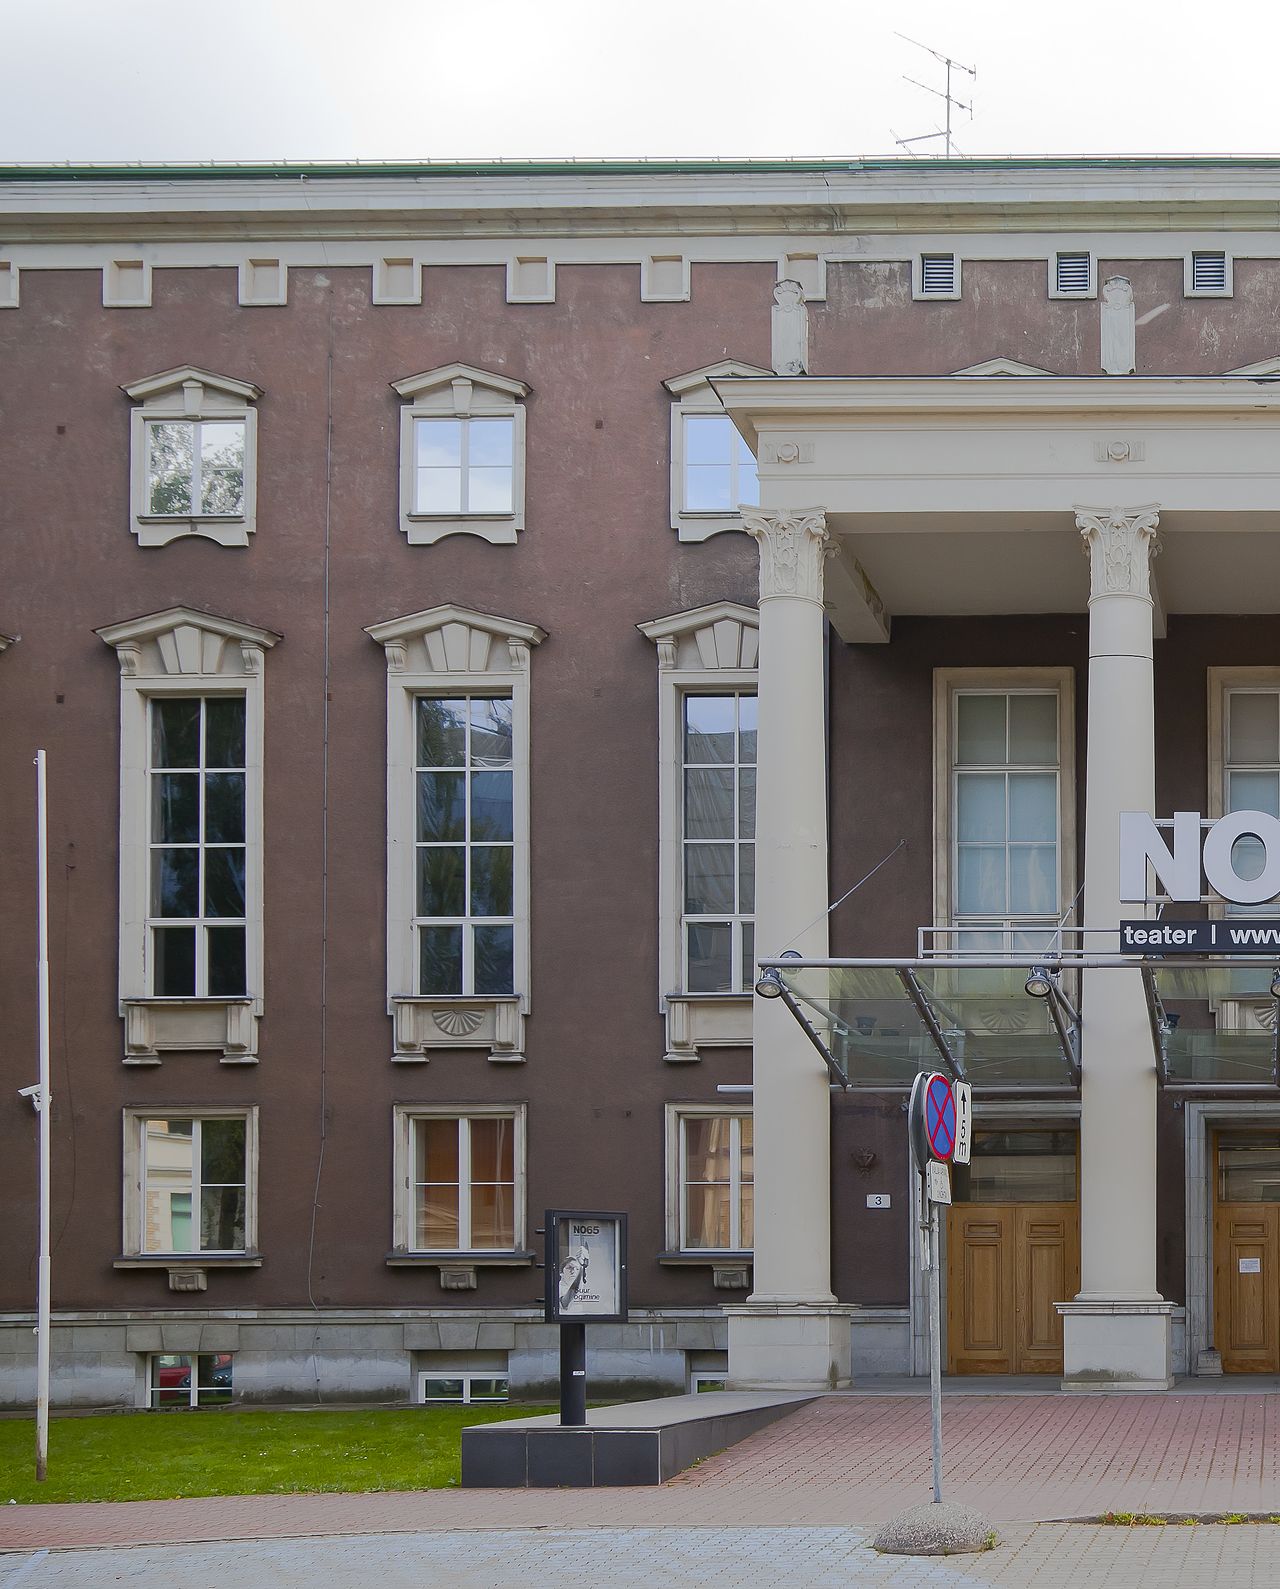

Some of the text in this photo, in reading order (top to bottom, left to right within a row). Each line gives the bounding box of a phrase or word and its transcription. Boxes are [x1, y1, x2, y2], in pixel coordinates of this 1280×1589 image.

[1124, 926, 1197, 945] teater
[959, 1120, 967, 1156] 5 m
[875, 1196, 882, 1206] 3
